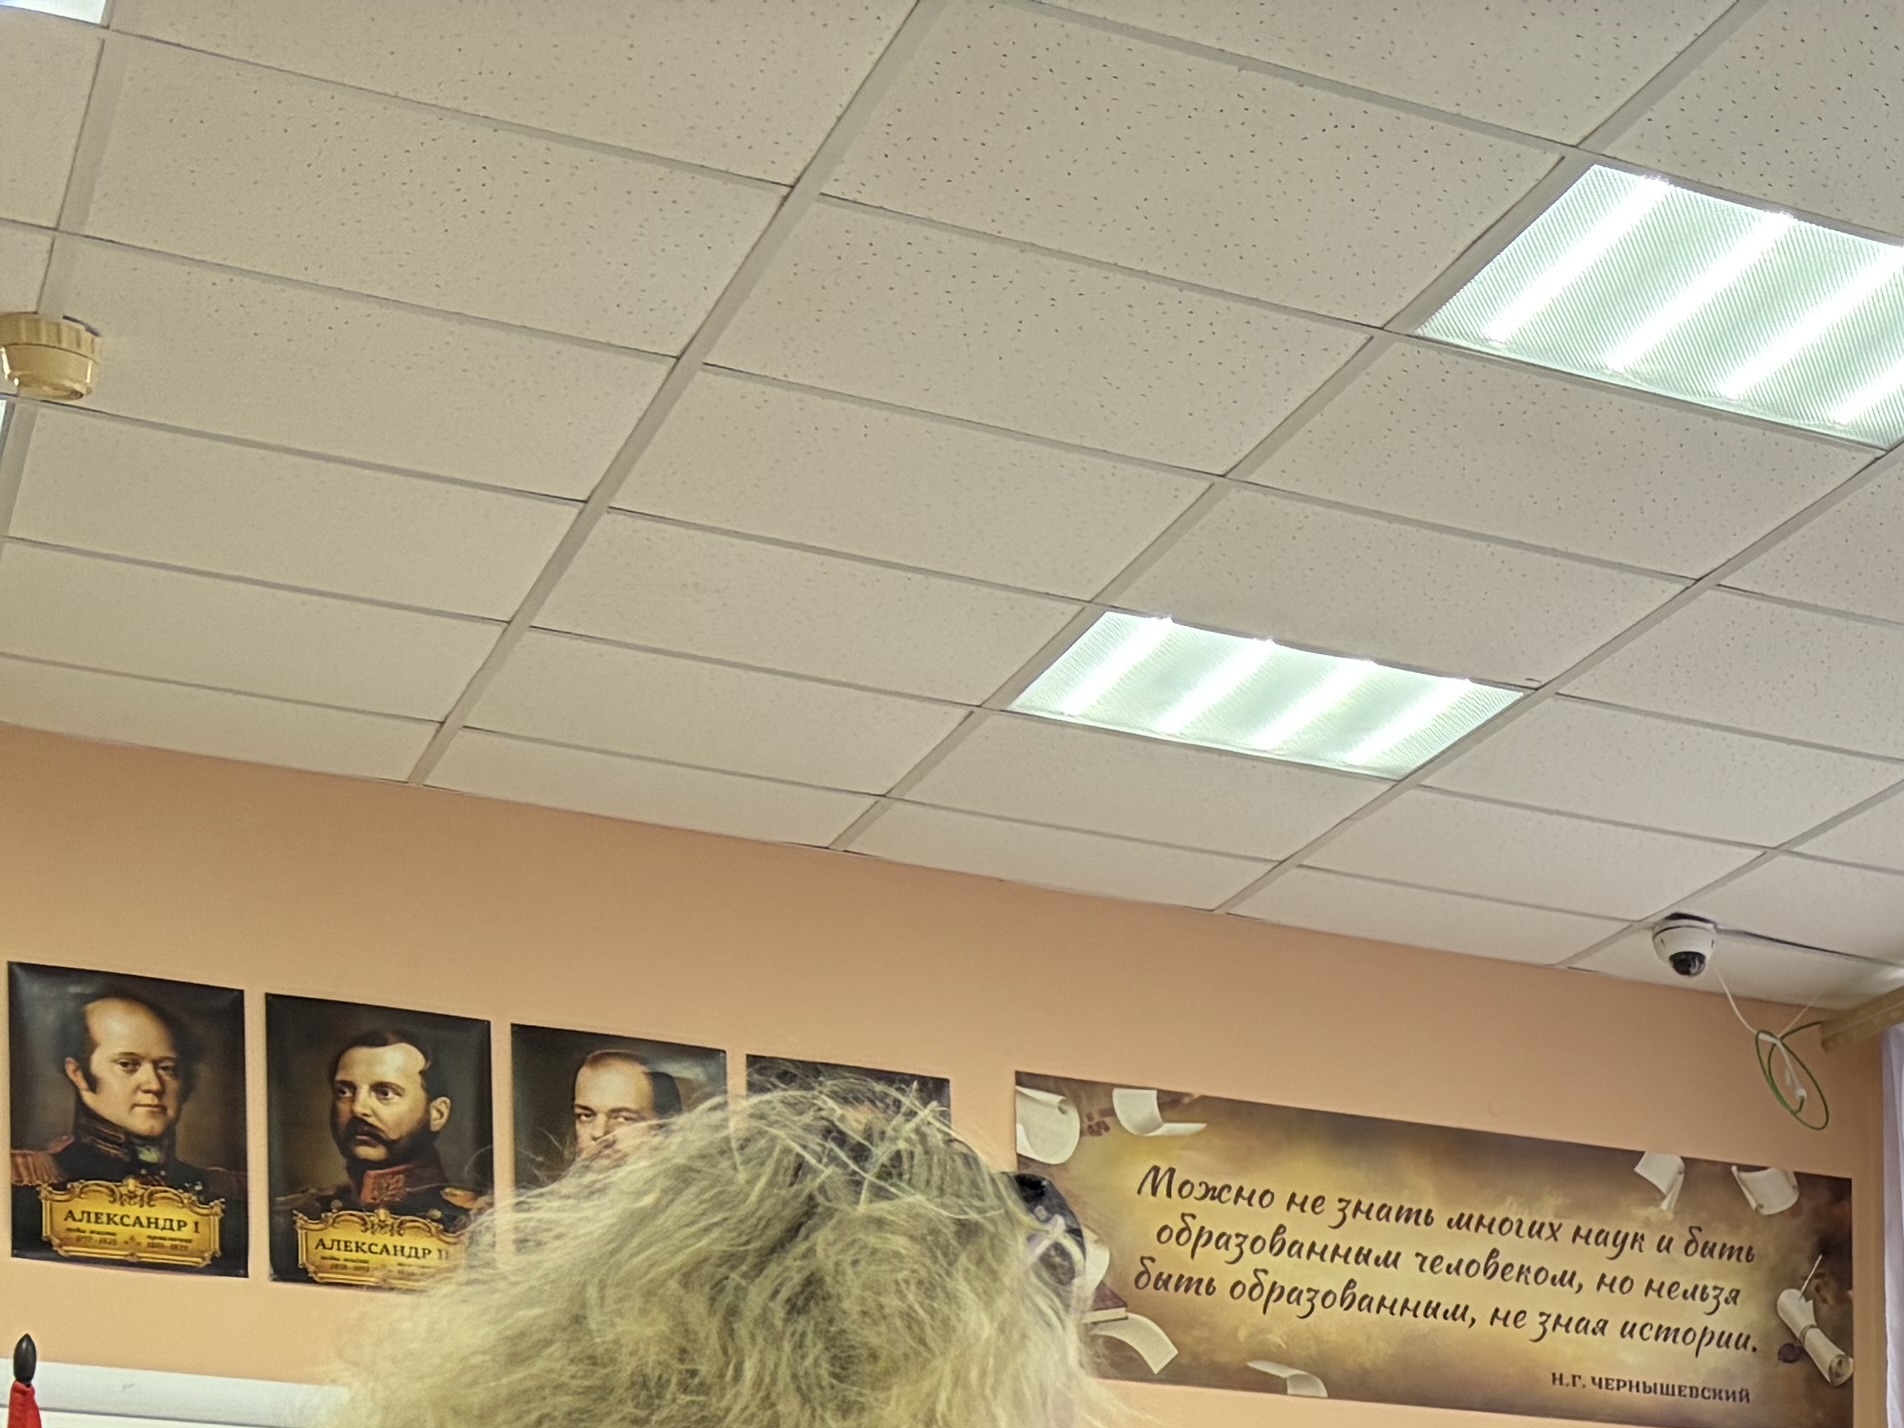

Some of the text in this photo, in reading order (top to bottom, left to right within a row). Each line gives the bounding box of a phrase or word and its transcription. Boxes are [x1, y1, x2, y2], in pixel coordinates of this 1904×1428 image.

[63, 1209, 188, 1232] АЛЕКСАНДР
[192, 1221, 201, 1234] I
[1137, 1164, 1756, 1263] Можно не знать многих наук и быть
[314, 1237, 433, 1260] АЛЕКСАНДР
[1155, 1212, 1742, 1315] образованным человеком, но нельзя
[1133, 1255, 1759, 1359] быть образованным, не зная истории.
[1550, 1371, 1752, 1405] Н.Г. ЧЕРНЫШЕВСКИЙ
